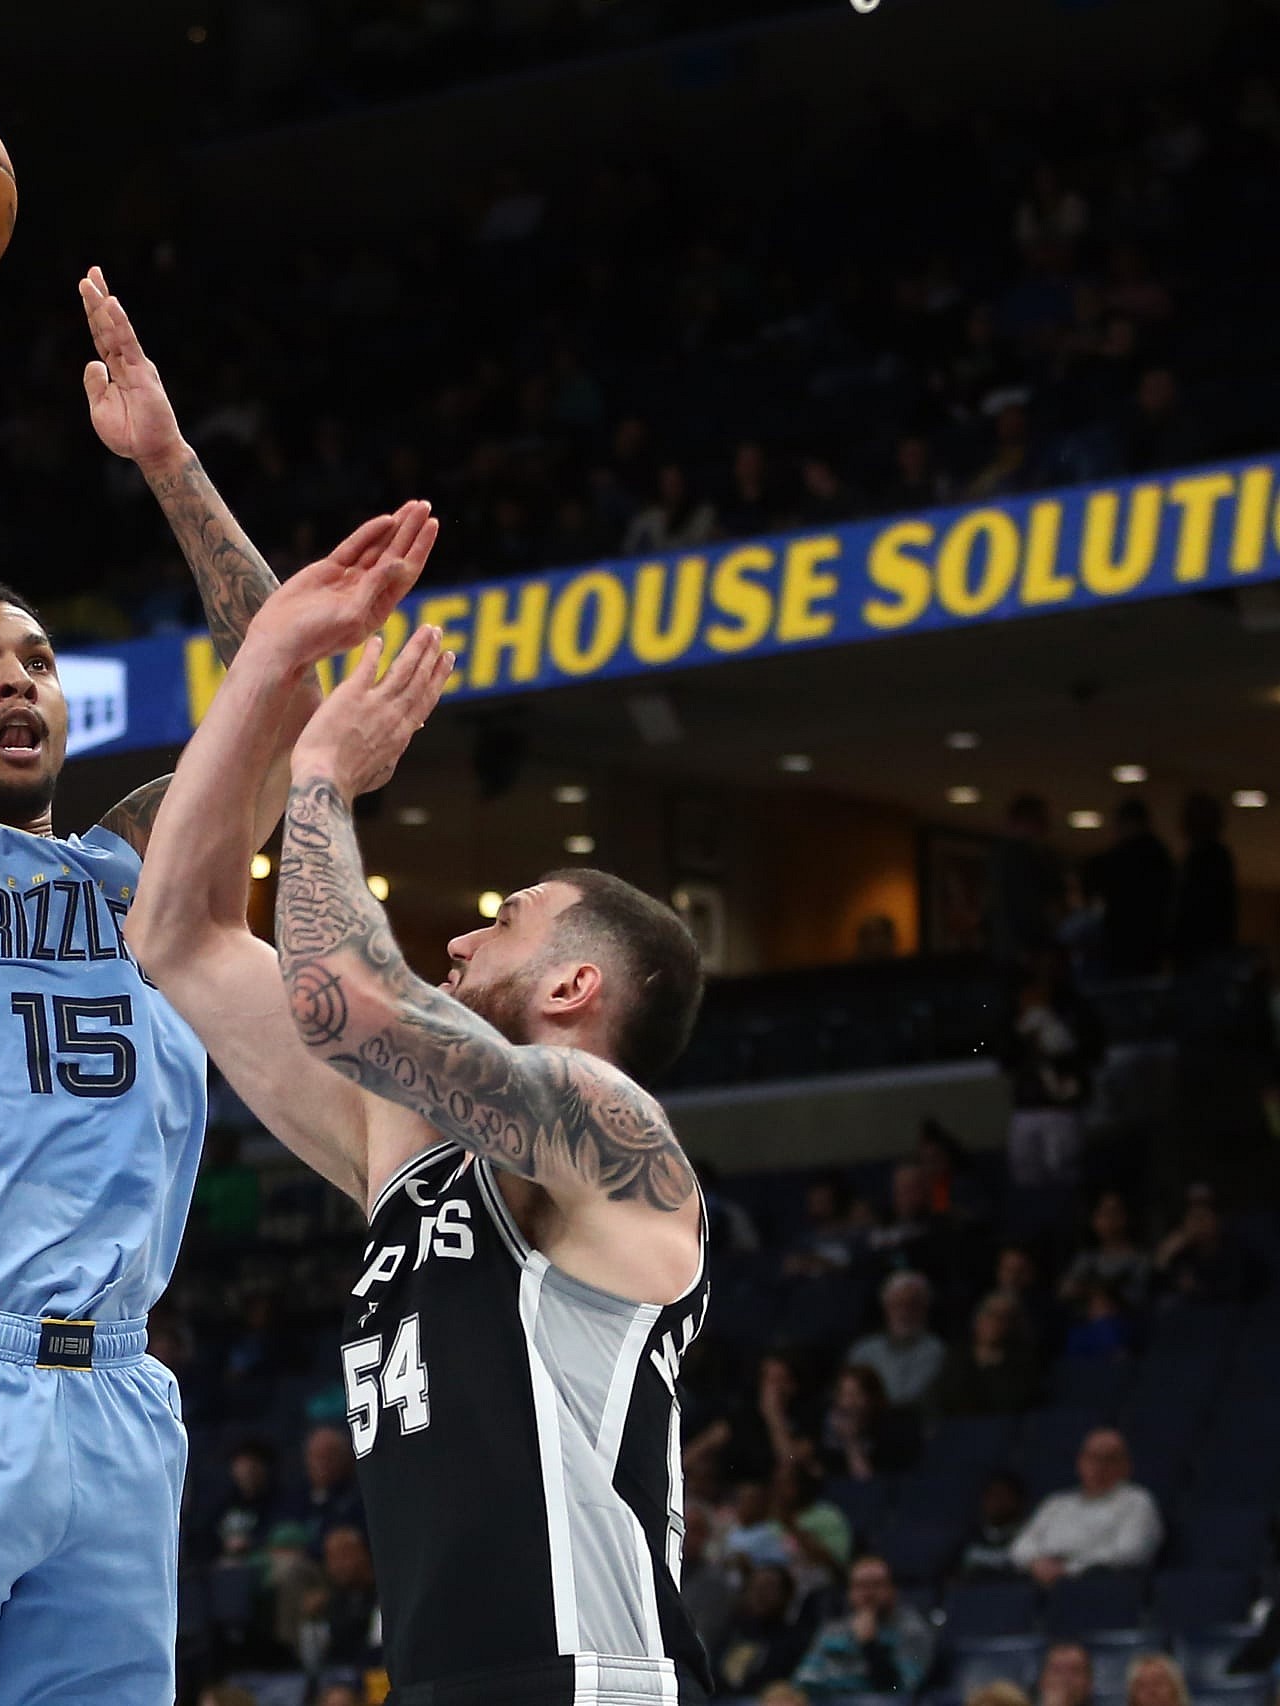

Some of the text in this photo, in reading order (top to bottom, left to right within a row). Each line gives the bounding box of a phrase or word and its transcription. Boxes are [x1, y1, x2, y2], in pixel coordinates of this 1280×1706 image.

[862, 465, 1280, 630] SOLUTI
[11, 992, 137, 1099] 15
[340, 1312, 431, 1460] 54
